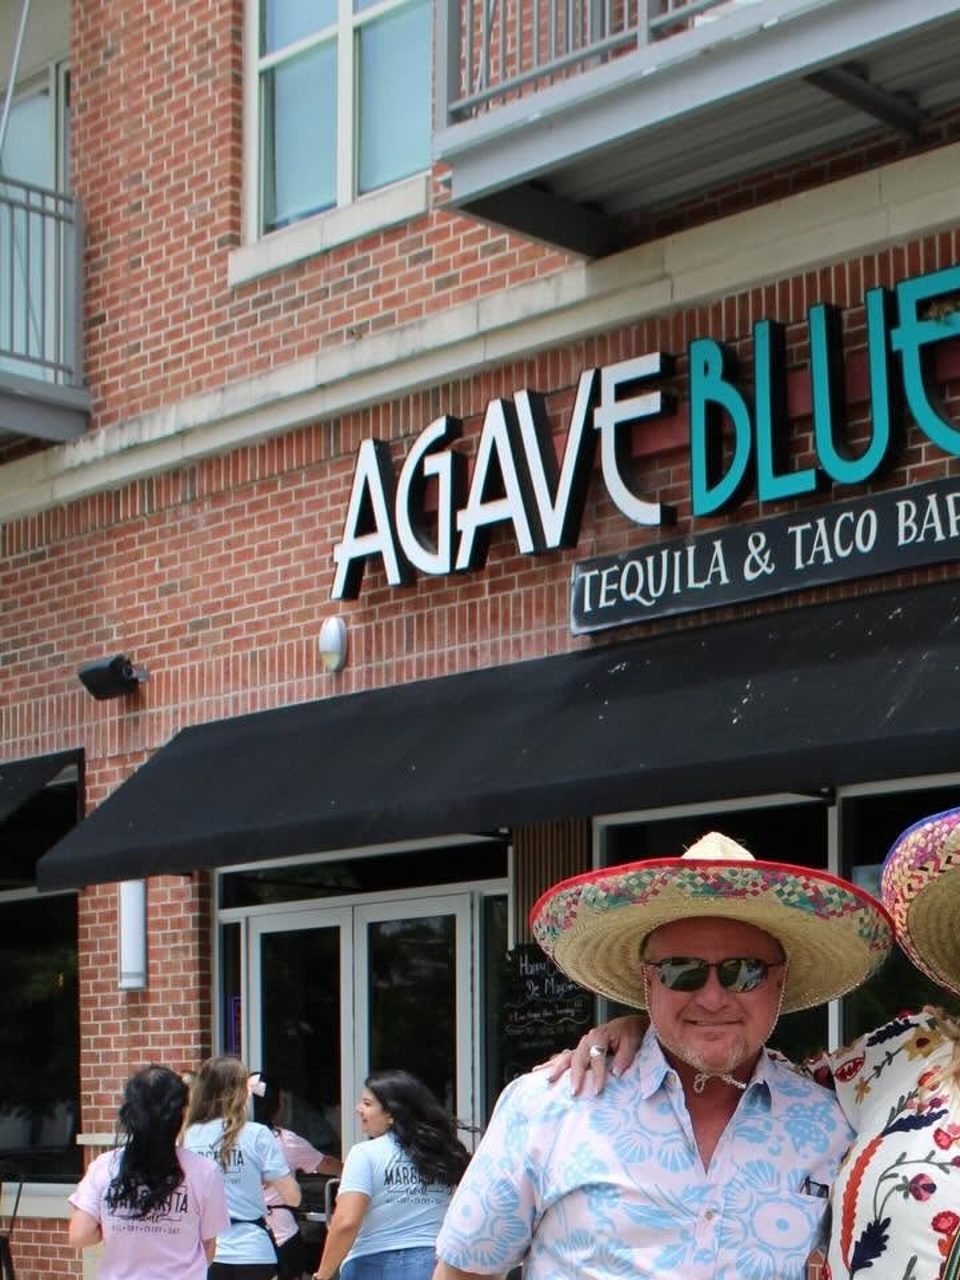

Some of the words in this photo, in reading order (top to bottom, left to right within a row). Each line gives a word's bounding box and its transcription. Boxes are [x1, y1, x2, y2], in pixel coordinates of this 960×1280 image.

[332, 352, 664, 600] AGAVE
[578, 539, 730, 613] TEQUILA
[743, 531, 775, 581] &
[788, 508, 878, 571] TACO
